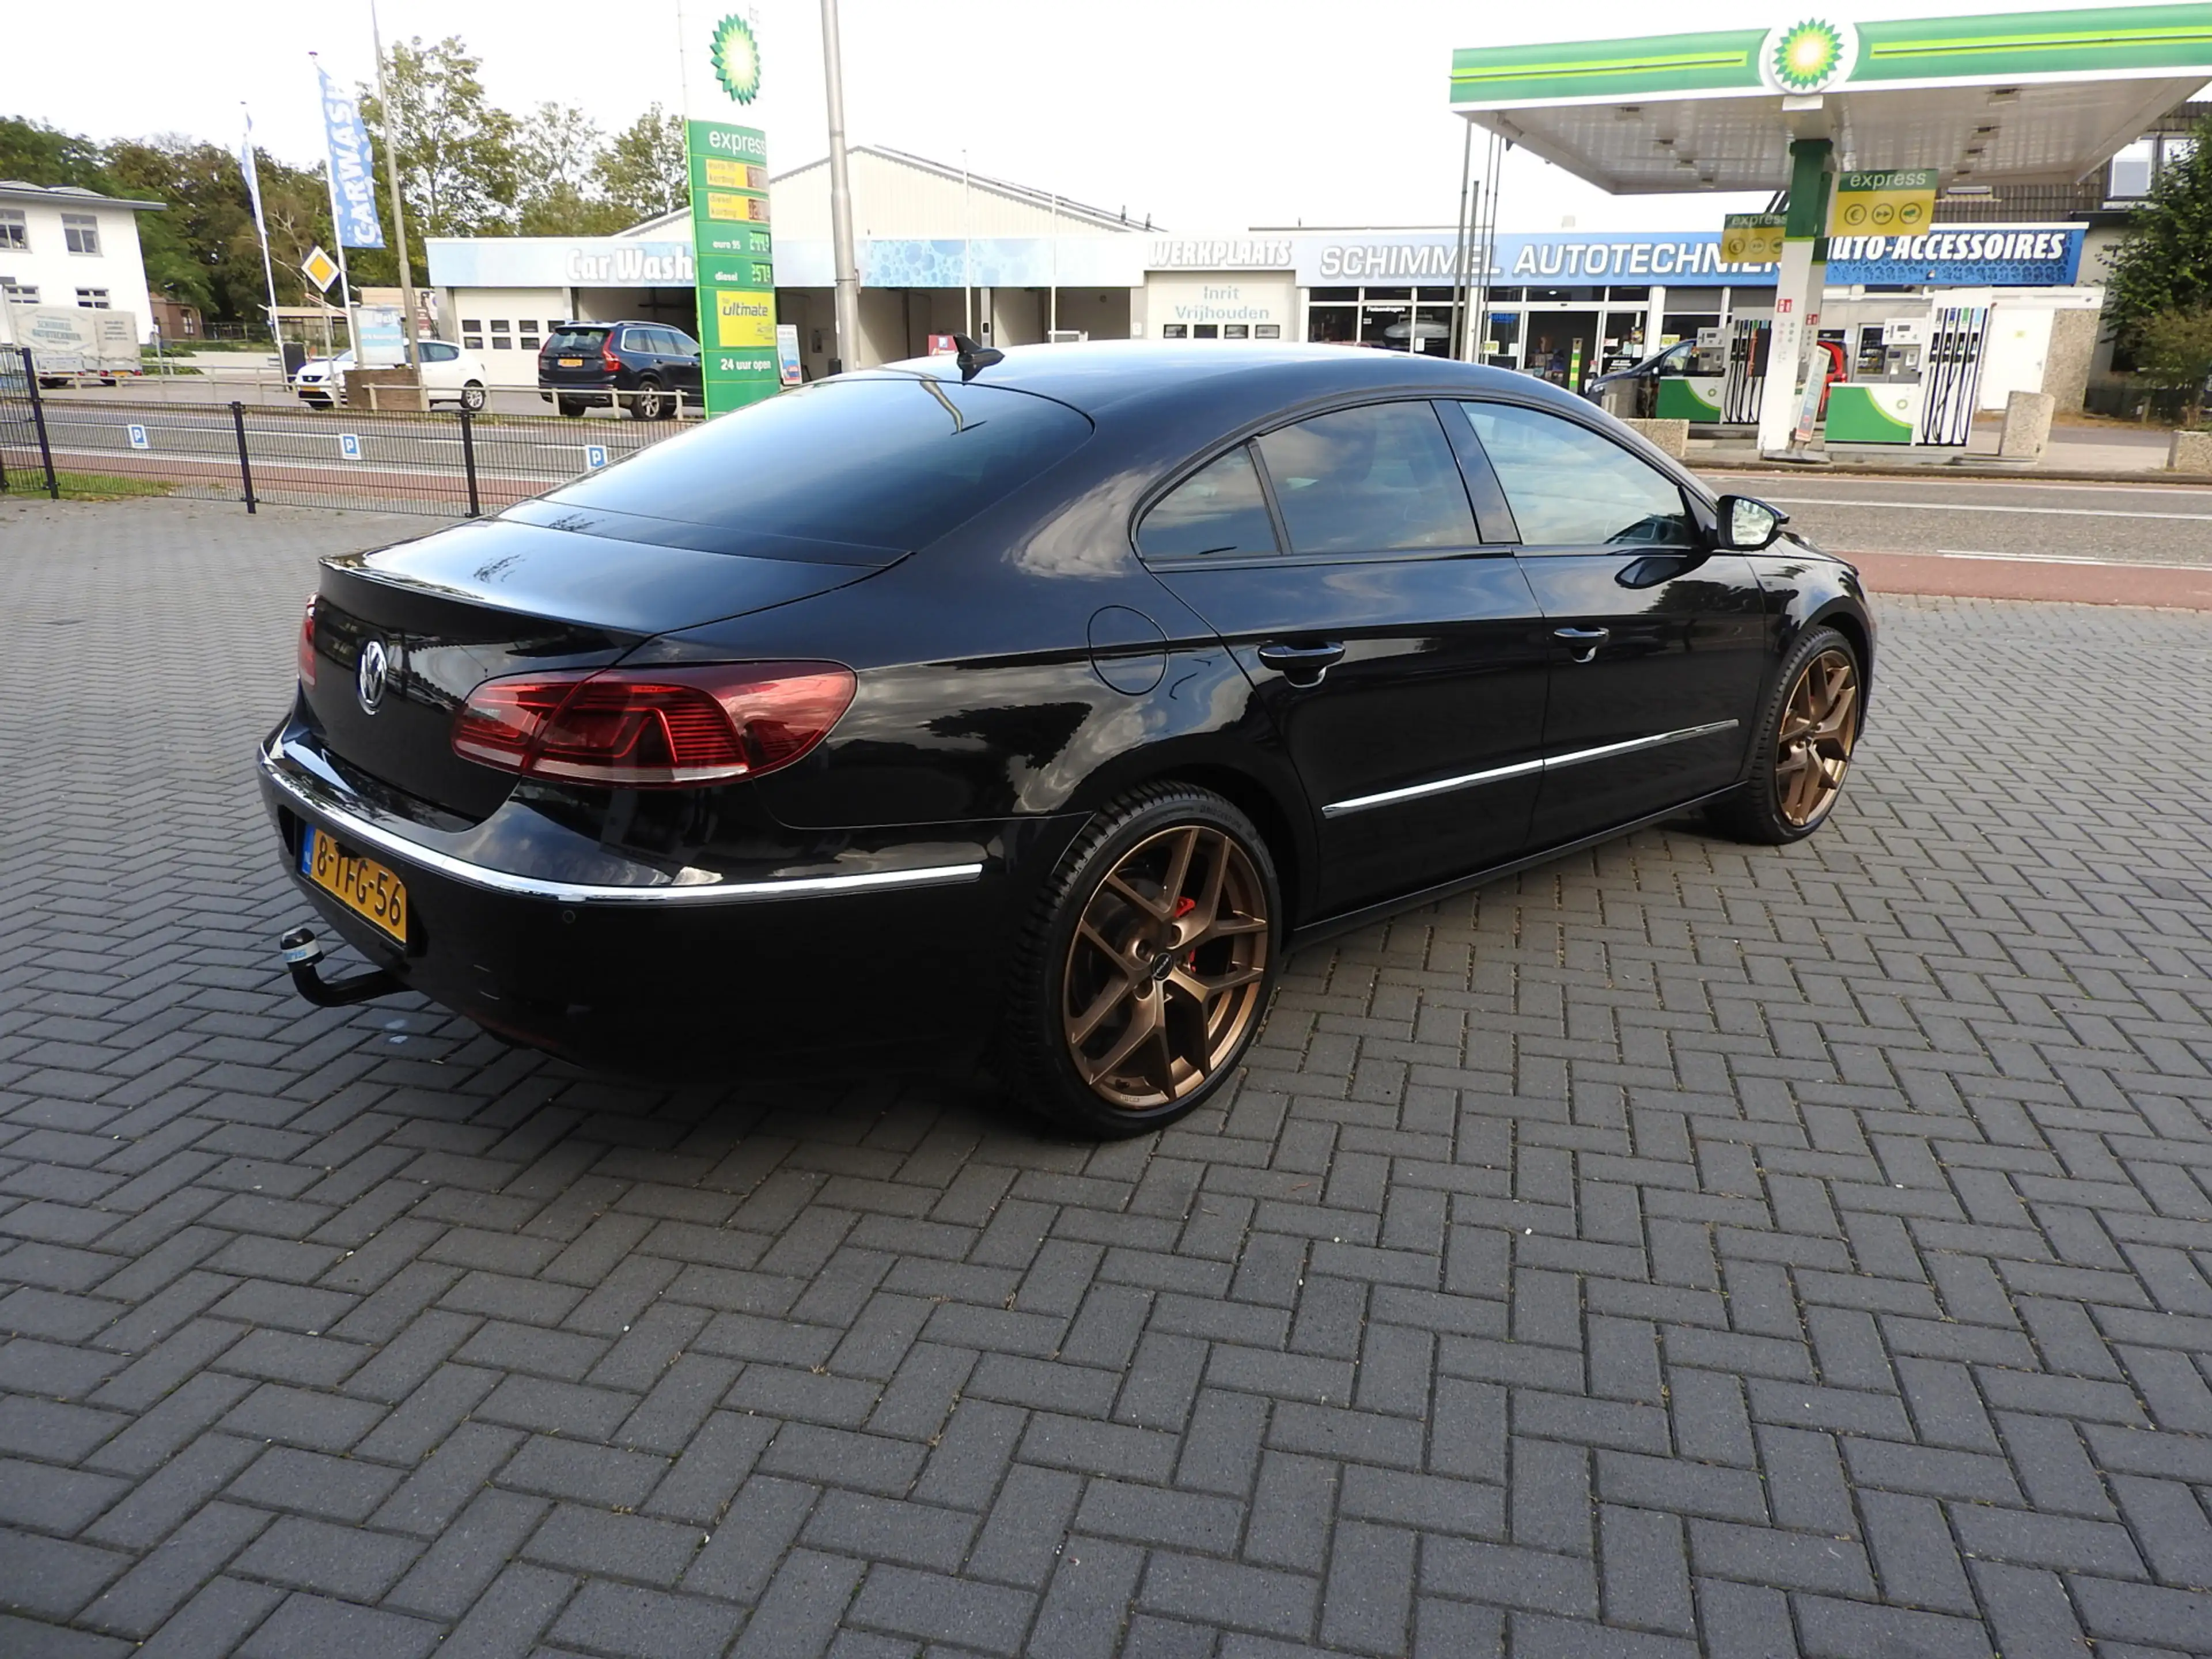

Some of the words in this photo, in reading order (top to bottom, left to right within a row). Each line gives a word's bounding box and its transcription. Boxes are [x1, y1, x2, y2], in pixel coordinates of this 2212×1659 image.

[709, 131, 766, 156] express
[324, 79, 377, 245] CARWASH
[1850, 172, 1927, 190] express
[1149, 240, 1292, 267] WERKPLAATS
[1320, 245, 1503, 277] SCHIMMEL
[566, 248, 611, 282] Car
[615, 245, 695, 282] Wash
[714, 271, 738, 281] diesel
[1203, 286, 1239, 300] Inrit
[722, 302, 768, 317] ultimate
[1175, 305, 1270, 322] Vrijhouden
[720, 358, 734, 370] 24
[736, 361, 752, 370] uur
[753, 360, 772, 372] open
[134, 426, 142, 441] P
[346, 438, 354, 452] P
[592, 450, 601, 465] P
